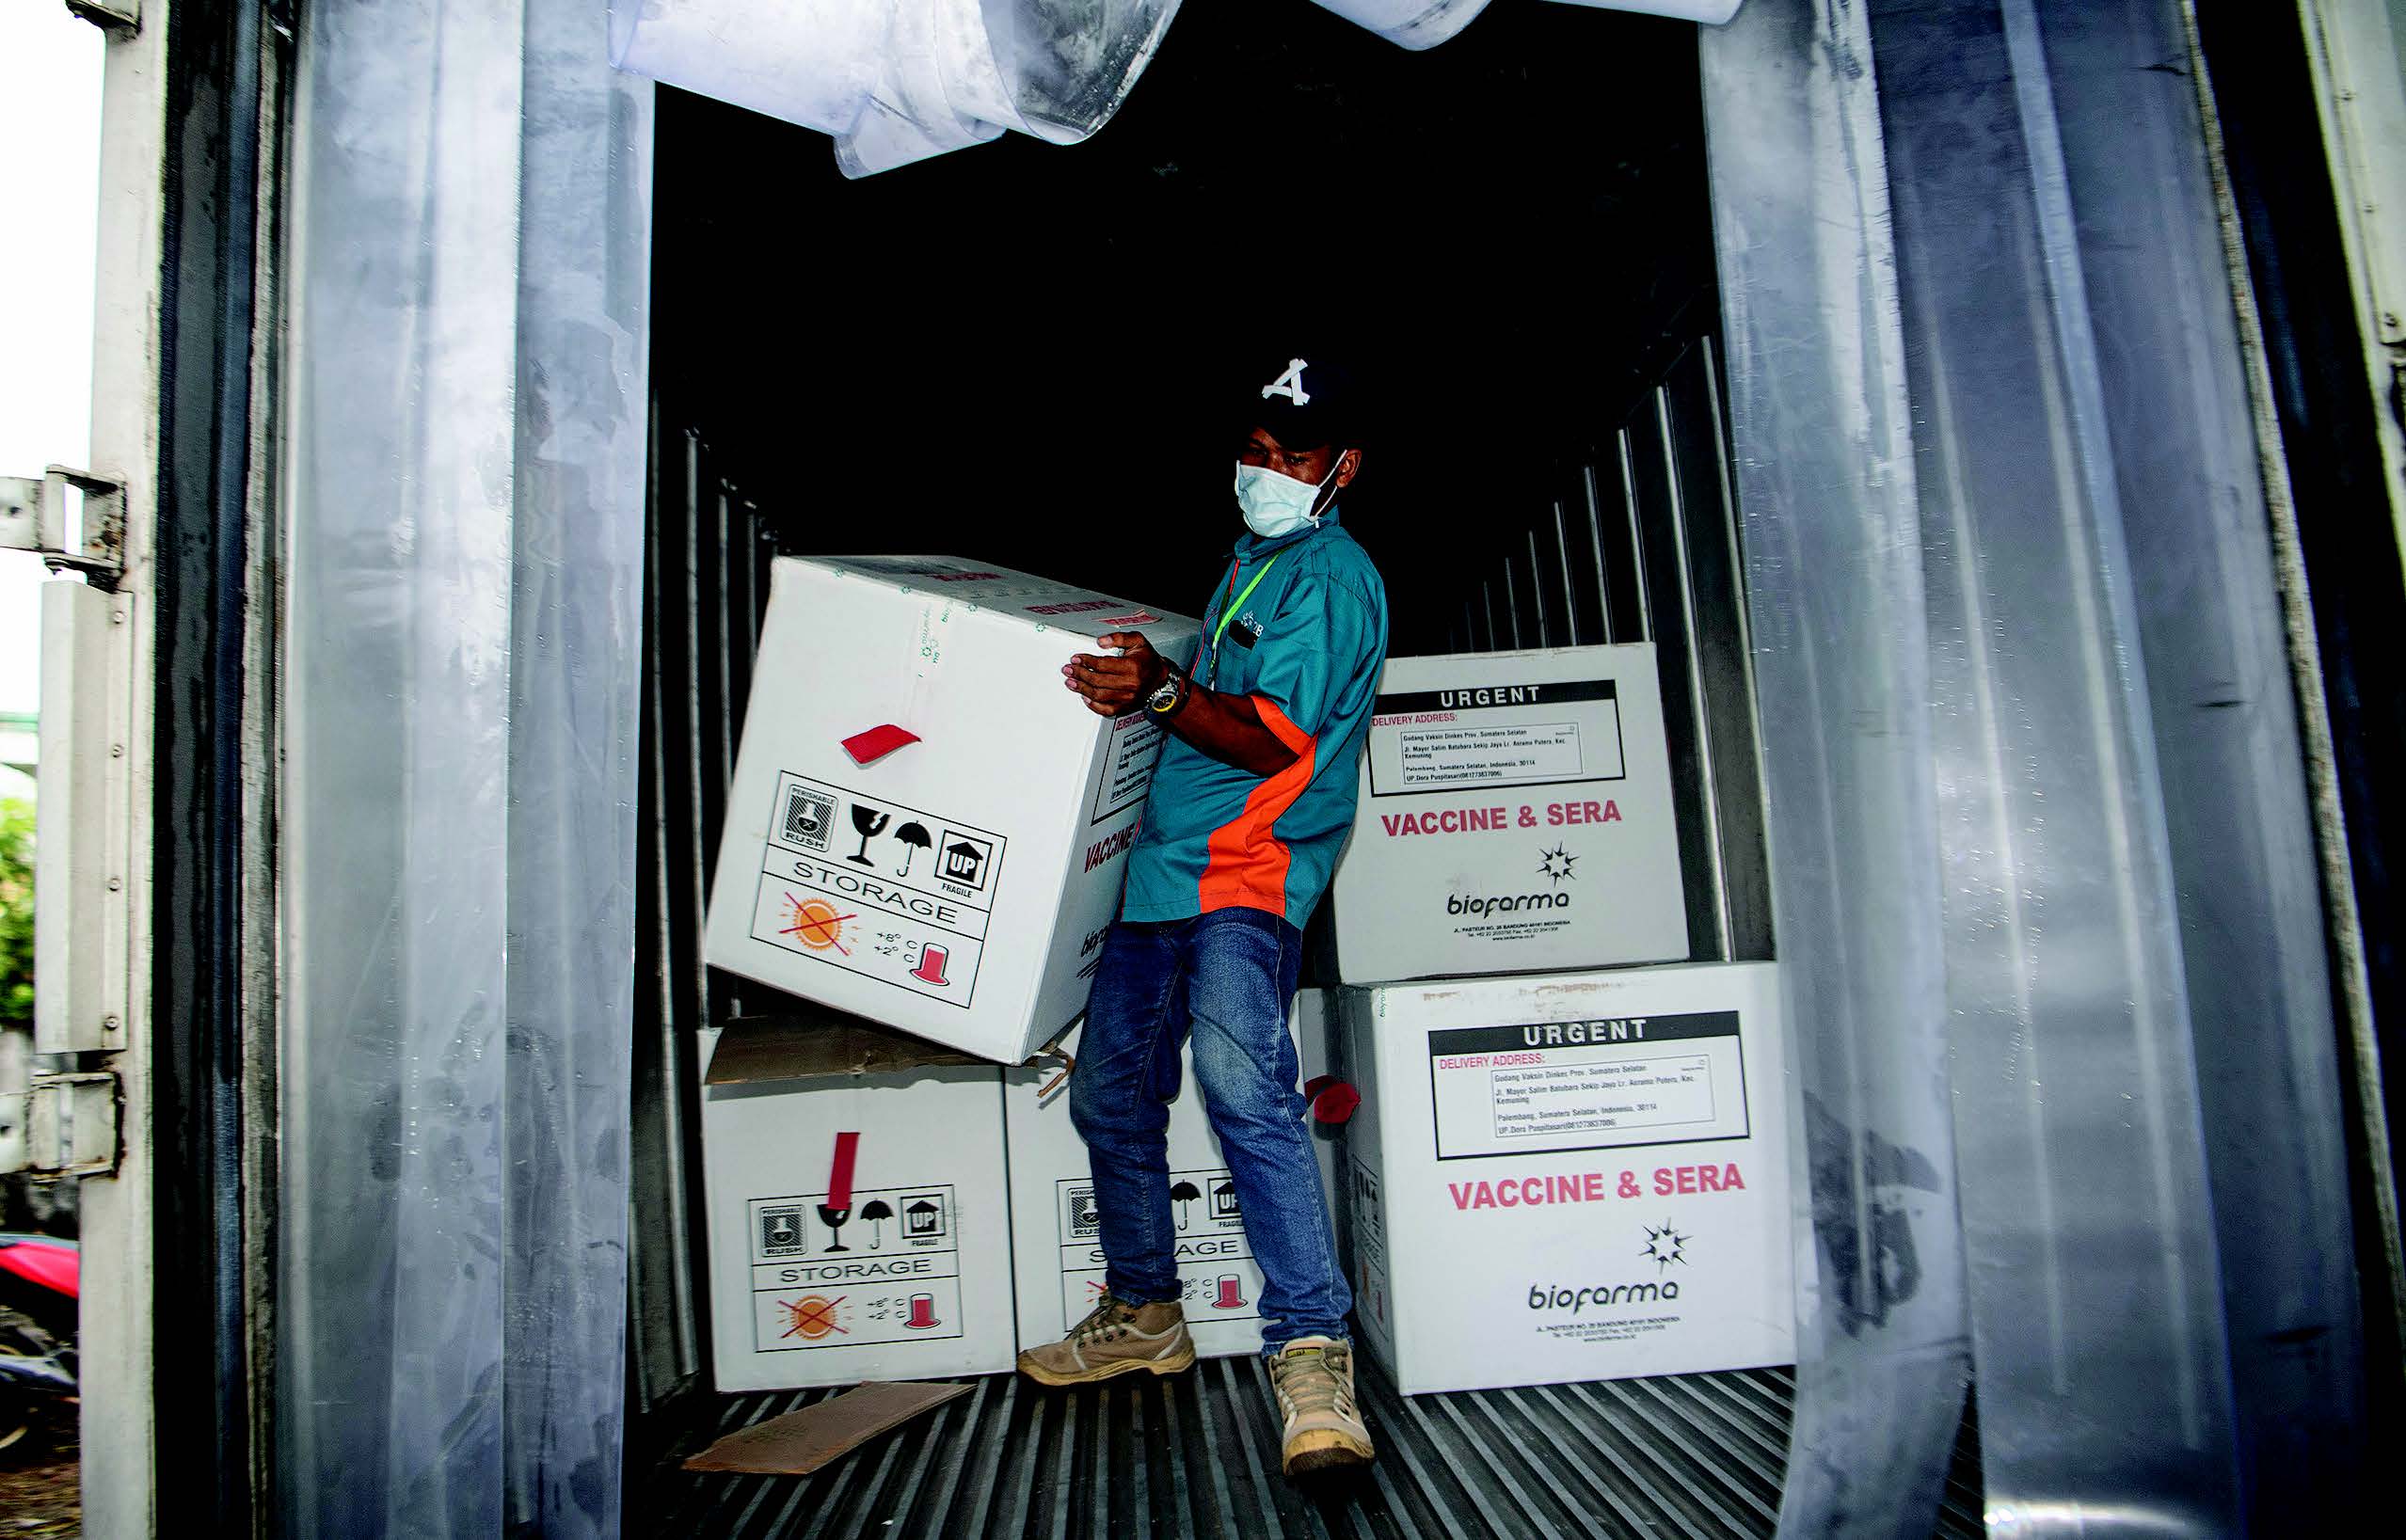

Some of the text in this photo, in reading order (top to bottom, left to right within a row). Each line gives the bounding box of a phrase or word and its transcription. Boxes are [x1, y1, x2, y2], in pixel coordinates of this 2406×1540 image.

[1263, 357, 1310, 406] A
[1441, 686, 1540, 707] URGENT
[1372, 713, 1458, 726] DELIVERY ADDRESS:
[792, 787, 836, 805] PERISHABLE
[1381, 800, 1622, 837] VACCINE & SERA
[785, 832, 824, 849] RUSH
[949, 852, 977, 875] UP
[793, 862, 958, 925] STORAGE
[942, 882, 973, 898] FRAGILE
[1446, 893, 1569, 919] biofarma
[1523, 1019, 1648, 1046] URGENT
[1440, 1054, 1546, 1070] DELIVERY ADDRESS:
[1448, 1163, 1745, 1211] VACCINE & SERA
[912, 1212, 935, 1228] UP
[780, 1259, 932, 1282] STORAGE
[1528, 1281, 1680, 1315] biofarma
